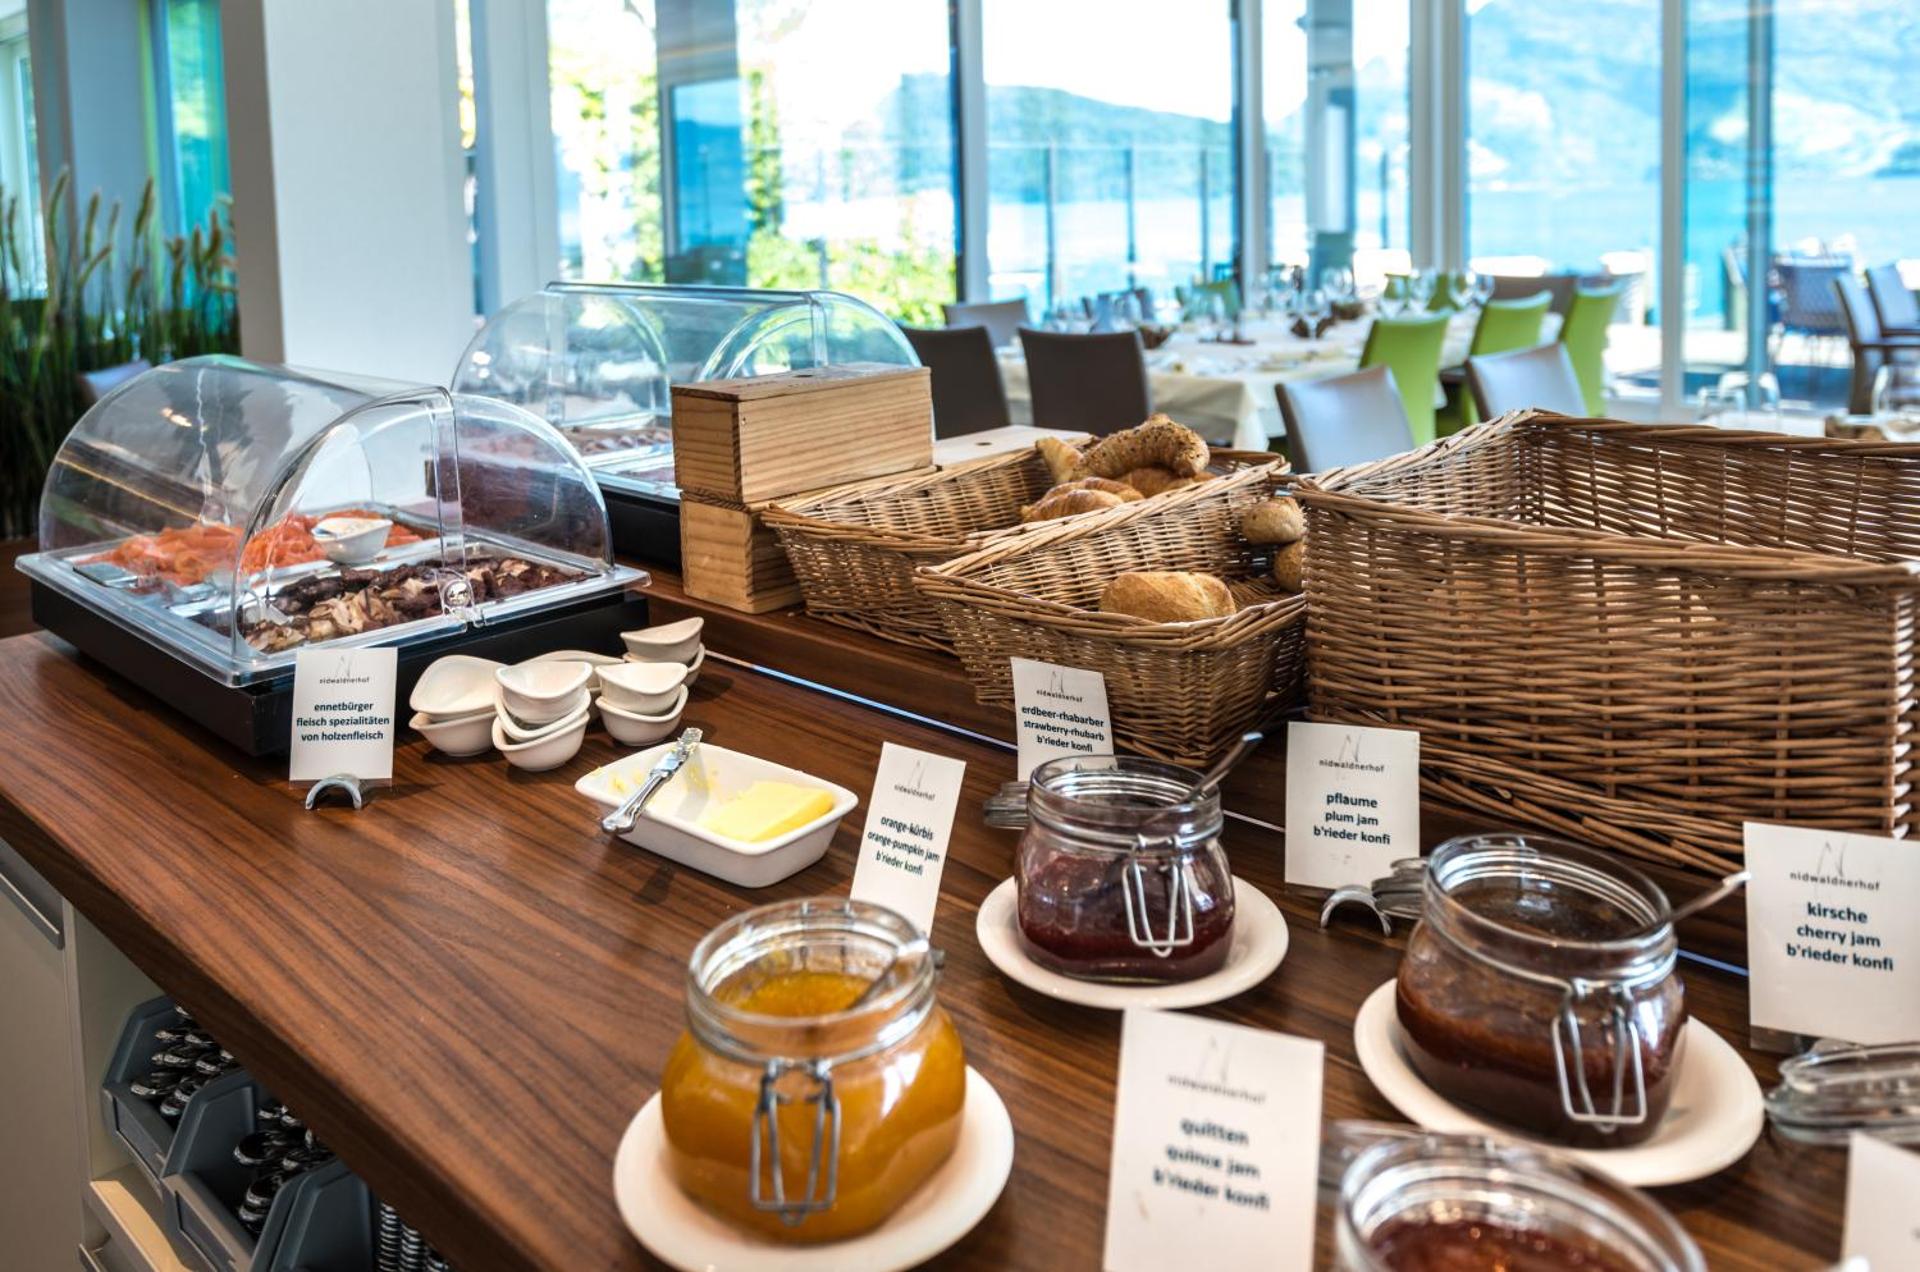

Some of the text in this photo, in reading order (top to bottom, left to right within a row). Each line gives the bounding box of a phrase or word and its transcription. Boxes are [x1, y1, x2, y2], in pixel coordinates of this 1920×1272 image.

[314, 702, 374, 712] ennetbürger
[1021, 706, 1105, 728] erdbeer-rhabarber
[296, 716, 390, 728] fleisch spezialitäten
[1023, 720, 1105, 742] strawberry-rhubarb
[301, 731, 384, 742] von holzenfleisch
[1037, 735, 1093, 752] b'rieder konfi
[1319, 759, 1385, 773] nidwaldnerhof
[1326, 792, 1378, 808] pflaume
[880, 816, 934, 841] orange-kürbis
[1325, 811, 1379, 826] plum jam
[1313, 825, 1391, 845] b'rieder konfi
[867, 831, 940, 862] orange-pumpkin jam
[876, 850, 923, 876] b'rieder konfi
[1790, 871, 1880, 891] nidwaldnerhof
[1807, 902, 1868, 924] kirsche
[1797, 924, 1881, 948] cherry jam
[1786, 943, 1894, 972] b'rieder konfi
[1180, 1119, 1249, 1146] quitten
[1166, 1146, 1261, 1180] quince jam
[1225, 1184, 1271, 1211] konfi
